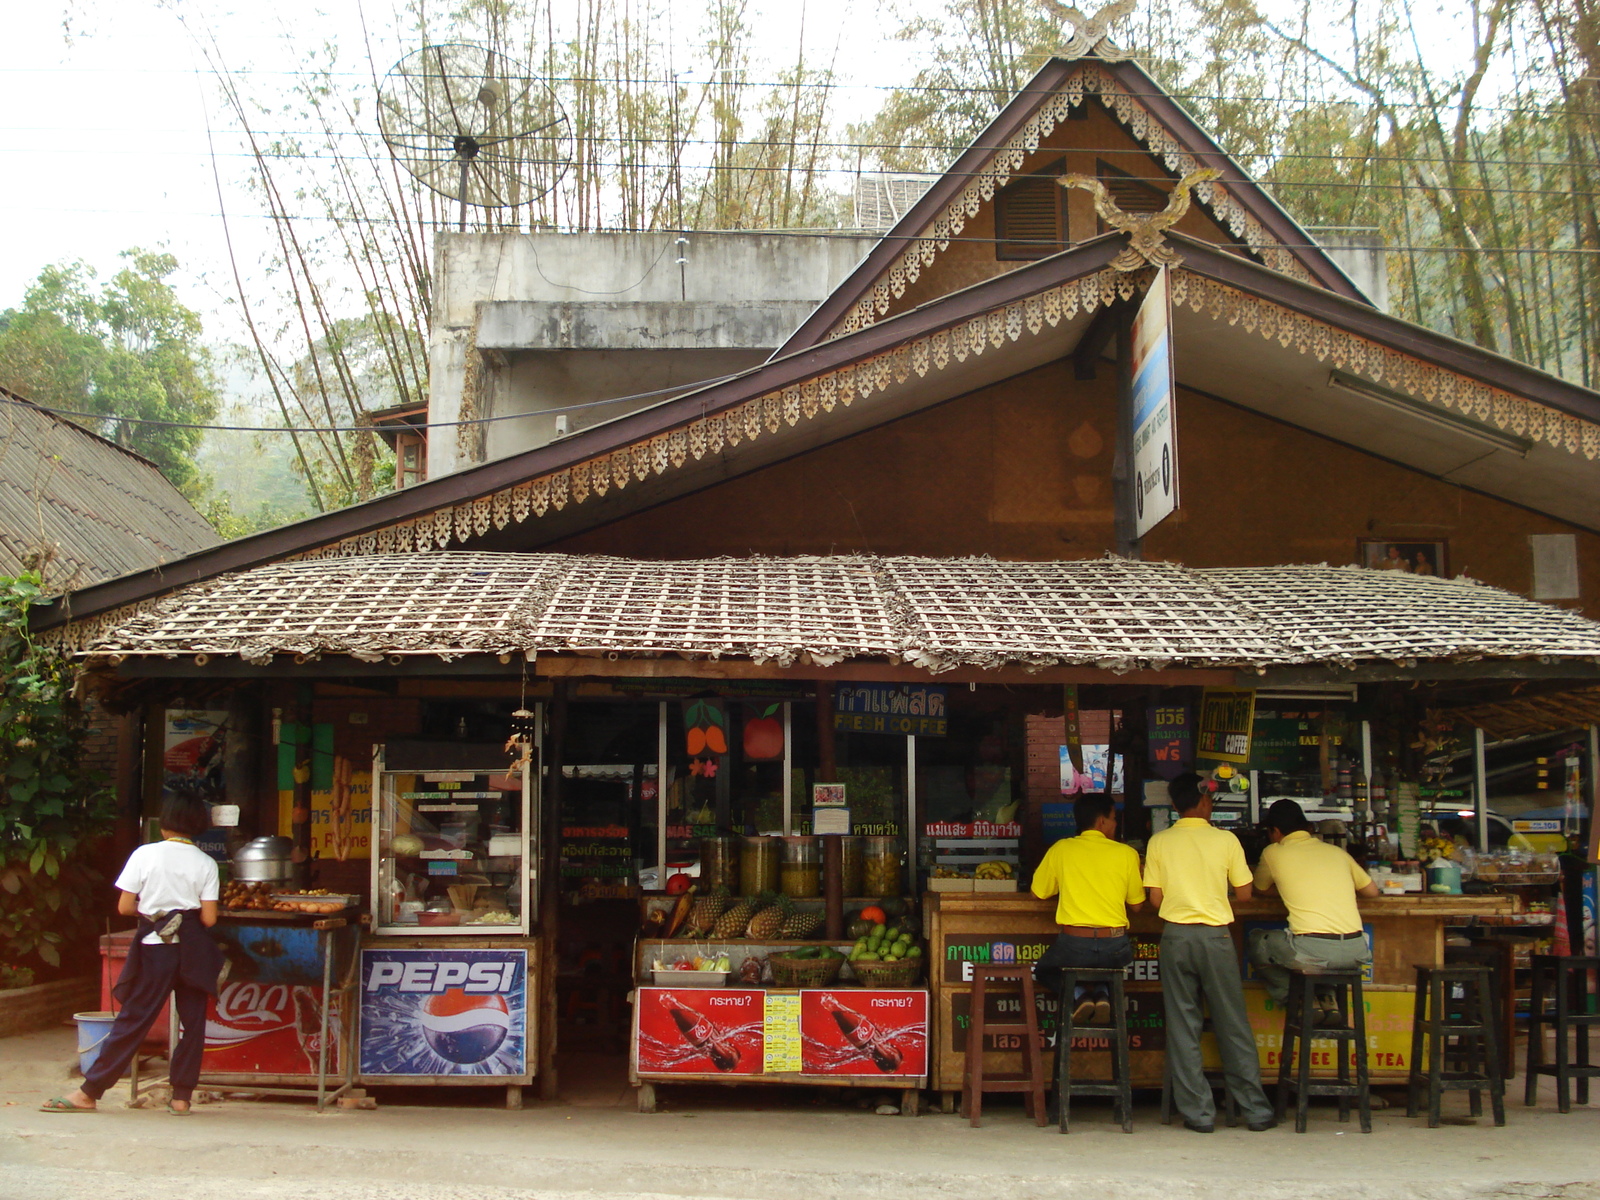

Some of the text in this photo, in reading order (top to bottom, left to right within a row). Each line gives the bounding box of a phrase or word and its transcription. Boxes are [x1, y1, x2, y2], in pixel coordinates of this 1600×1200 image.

[840, 686, 945, 717] กาแฟสด
[834, 714, 947, 735] FRESH COFFEE
[1155, 707, 1185, 725] มีวิธี
[1155, 740, 1180, 761] ฟรี
[1225, 734, 1249, 754] COFFEE
[854, 821, 898, 836] ครบครัน
[927, 820, 1021, 836] แม่แสะ มินิมาร์ท
[195, 841, 227, 854] tasoy
[367, 961, 516, 992] PEPSI
[1123, 960, 1160, 981] FEE
[1376, 1053, 1405, 1067] TEA
